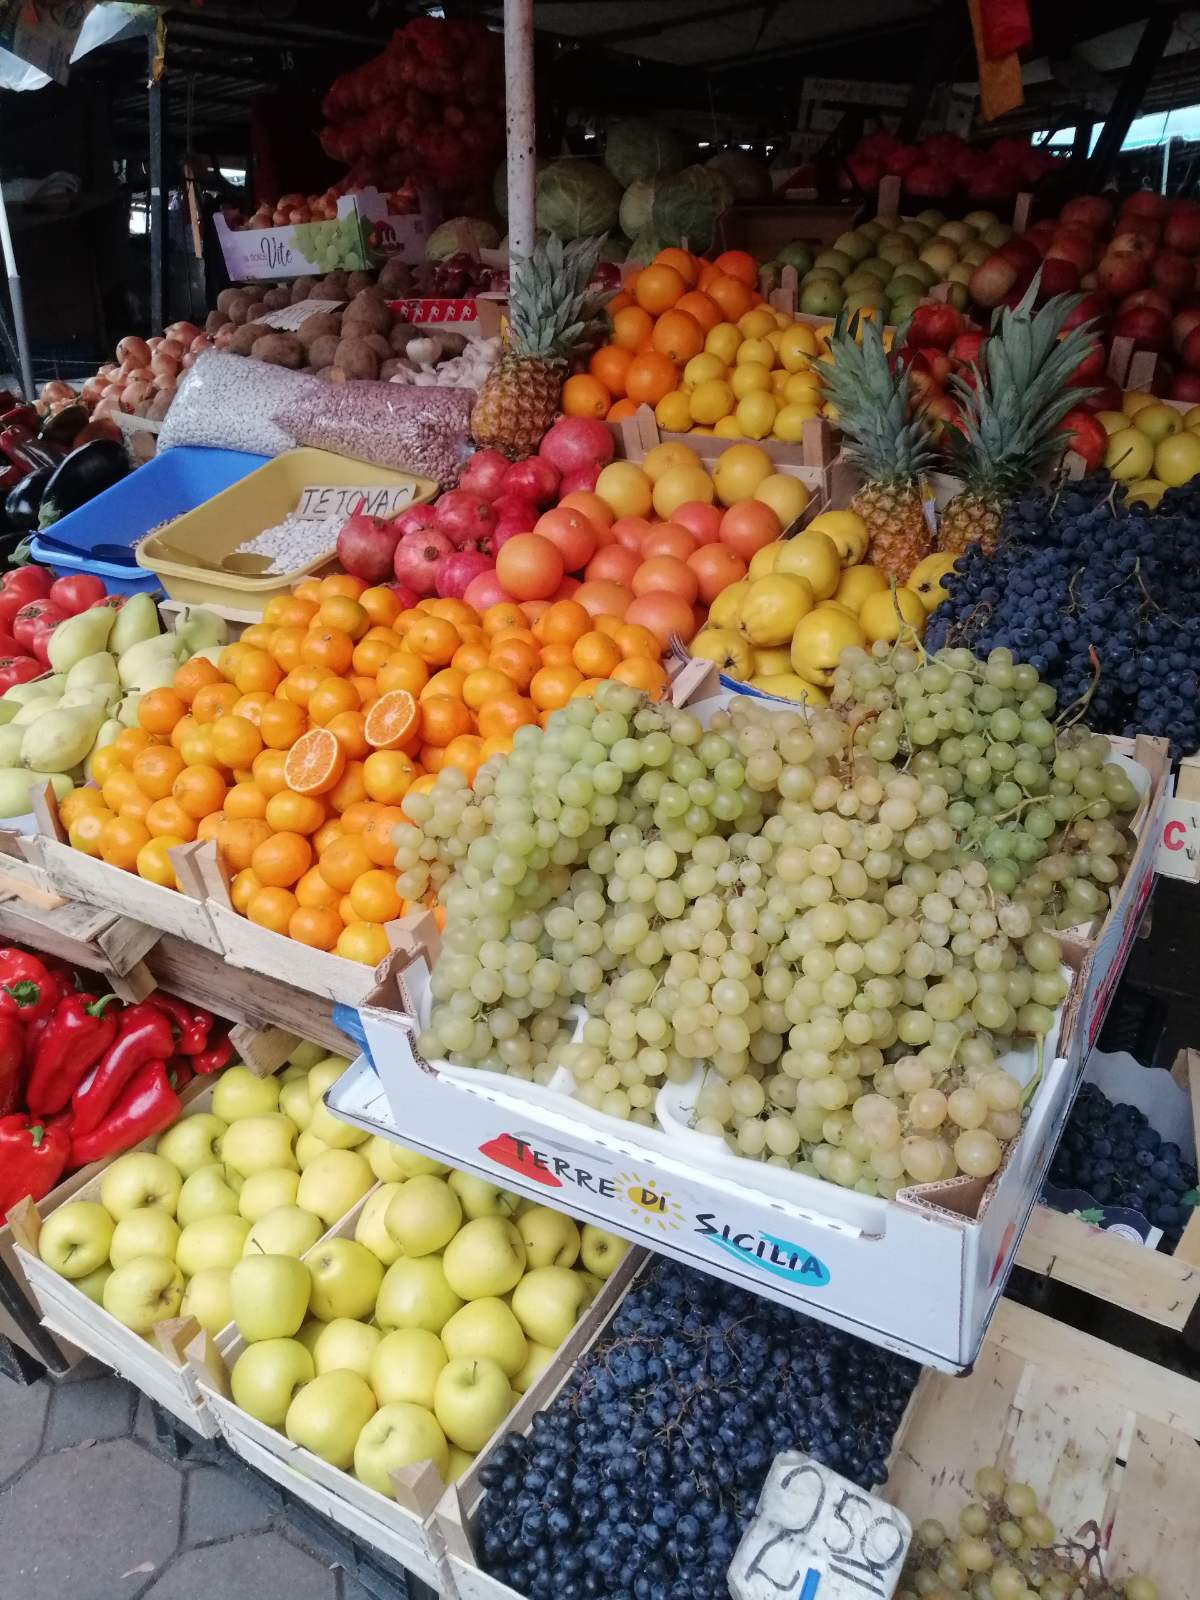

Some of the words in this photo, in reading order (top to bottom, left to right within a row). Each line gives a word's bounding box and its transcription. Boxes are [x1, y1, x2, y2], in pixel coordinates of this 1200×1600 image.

[506, 1134, 616, 1199] TERRE
[641, 1187, 667, 1212] DI
[693, 1213, 824, 1279] SICILIA
